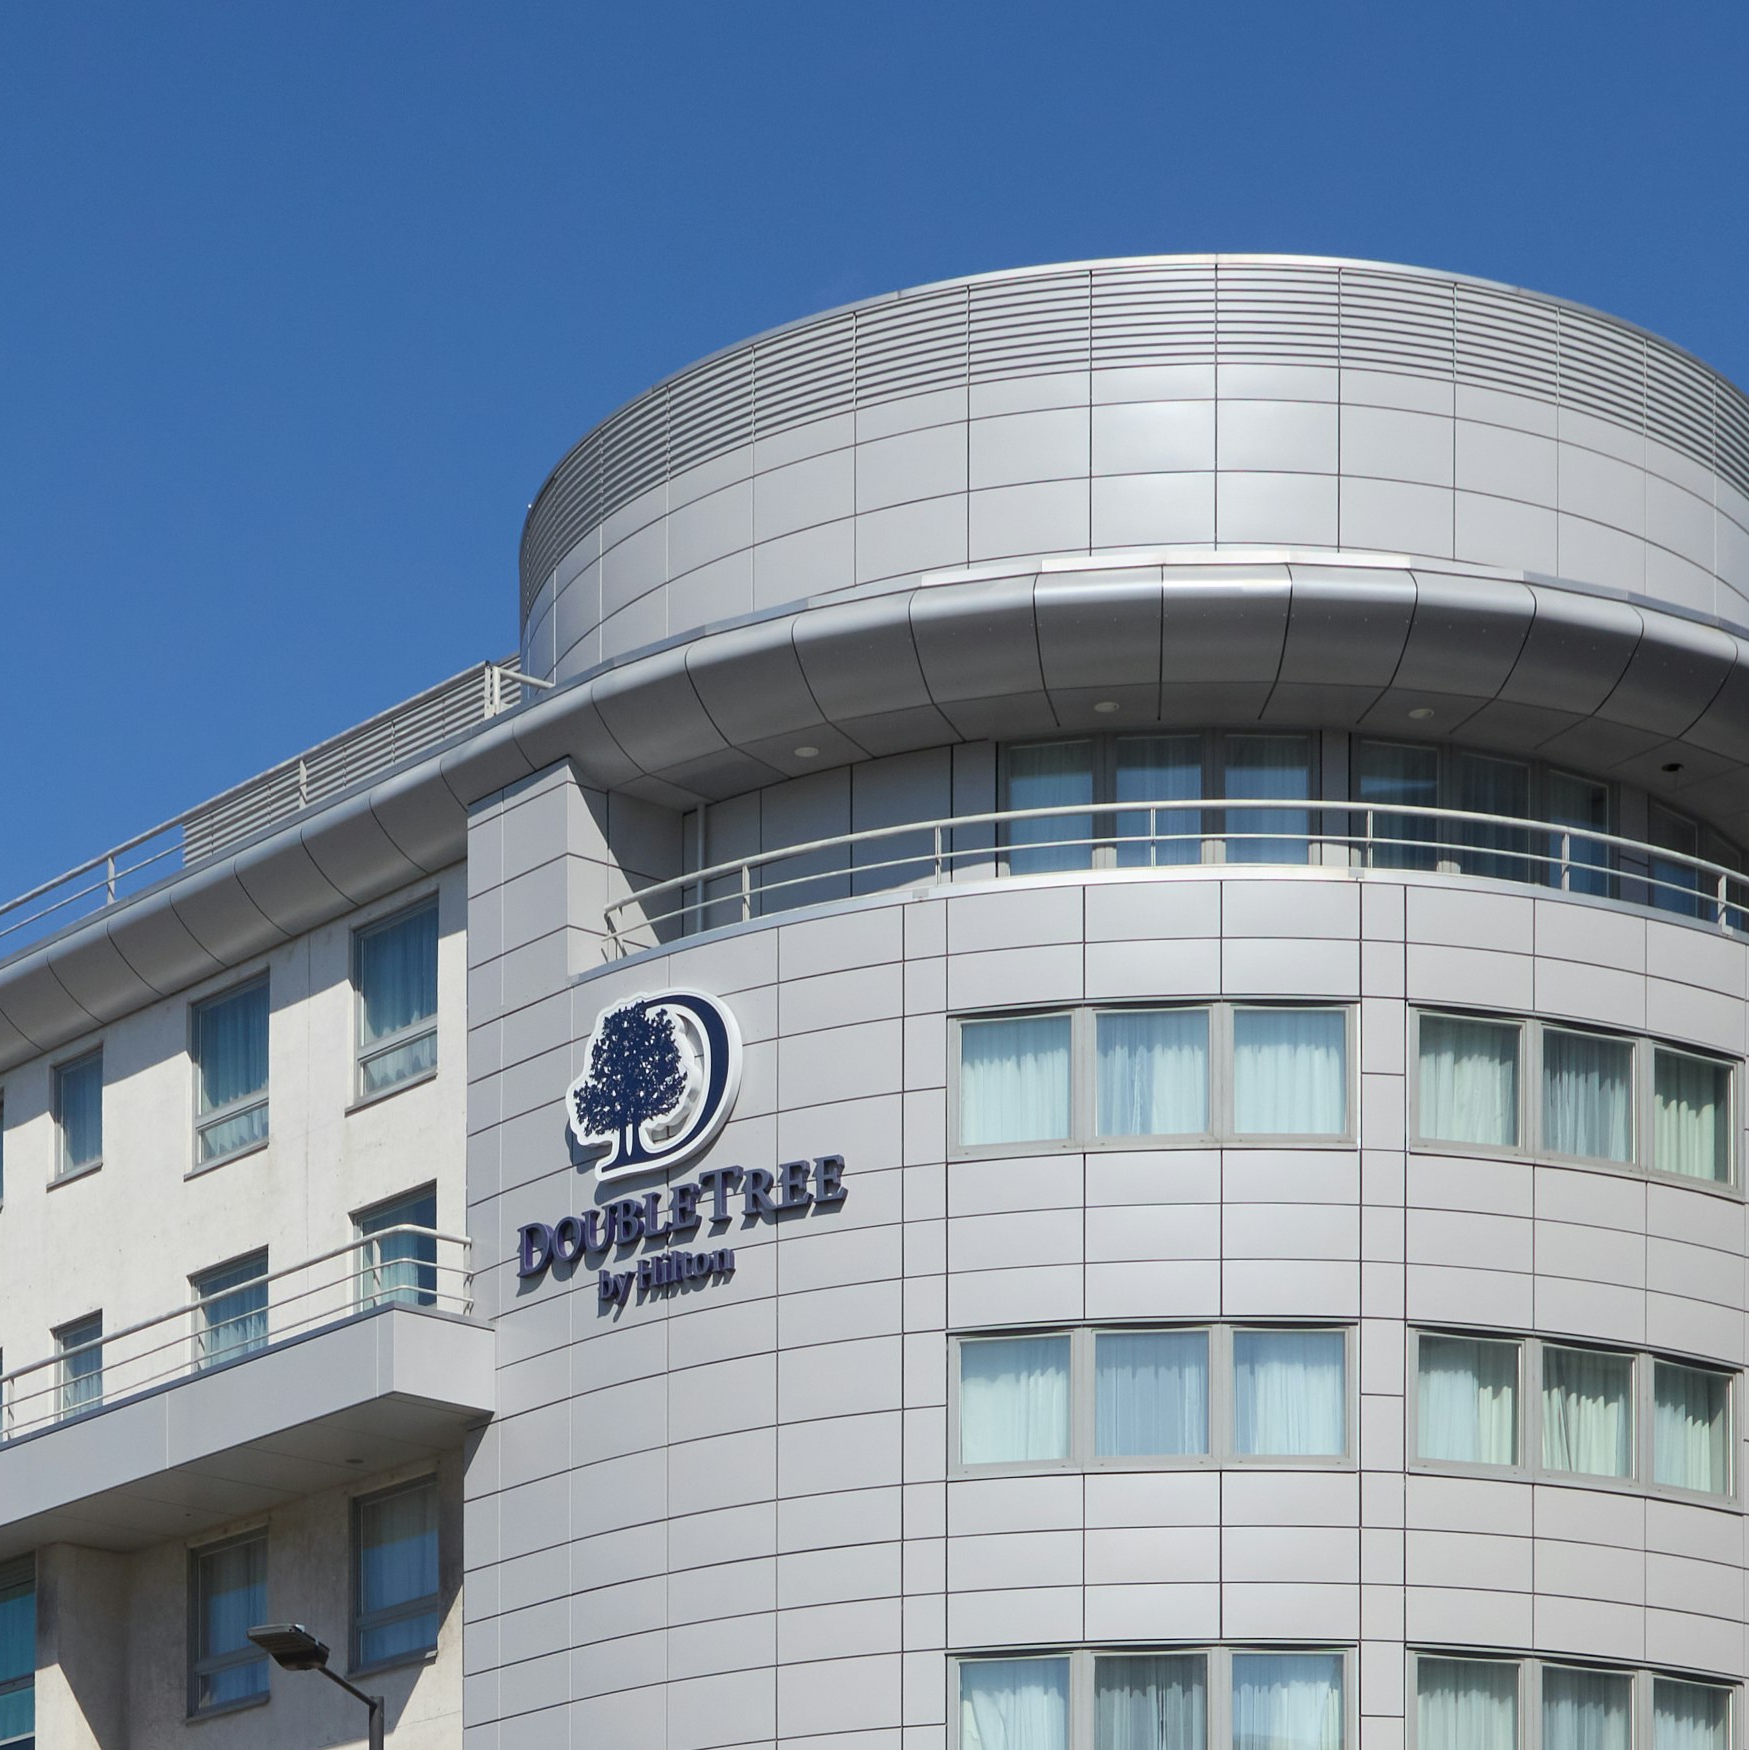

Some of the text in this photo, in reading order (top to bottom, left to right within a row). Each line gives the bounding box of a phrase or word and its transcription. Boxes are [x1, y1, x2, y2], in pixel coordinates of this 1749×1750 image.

[516, 1154, 848, 1279] DOUBLETREE
[598, 1247, 736, 1302] by Hilton
